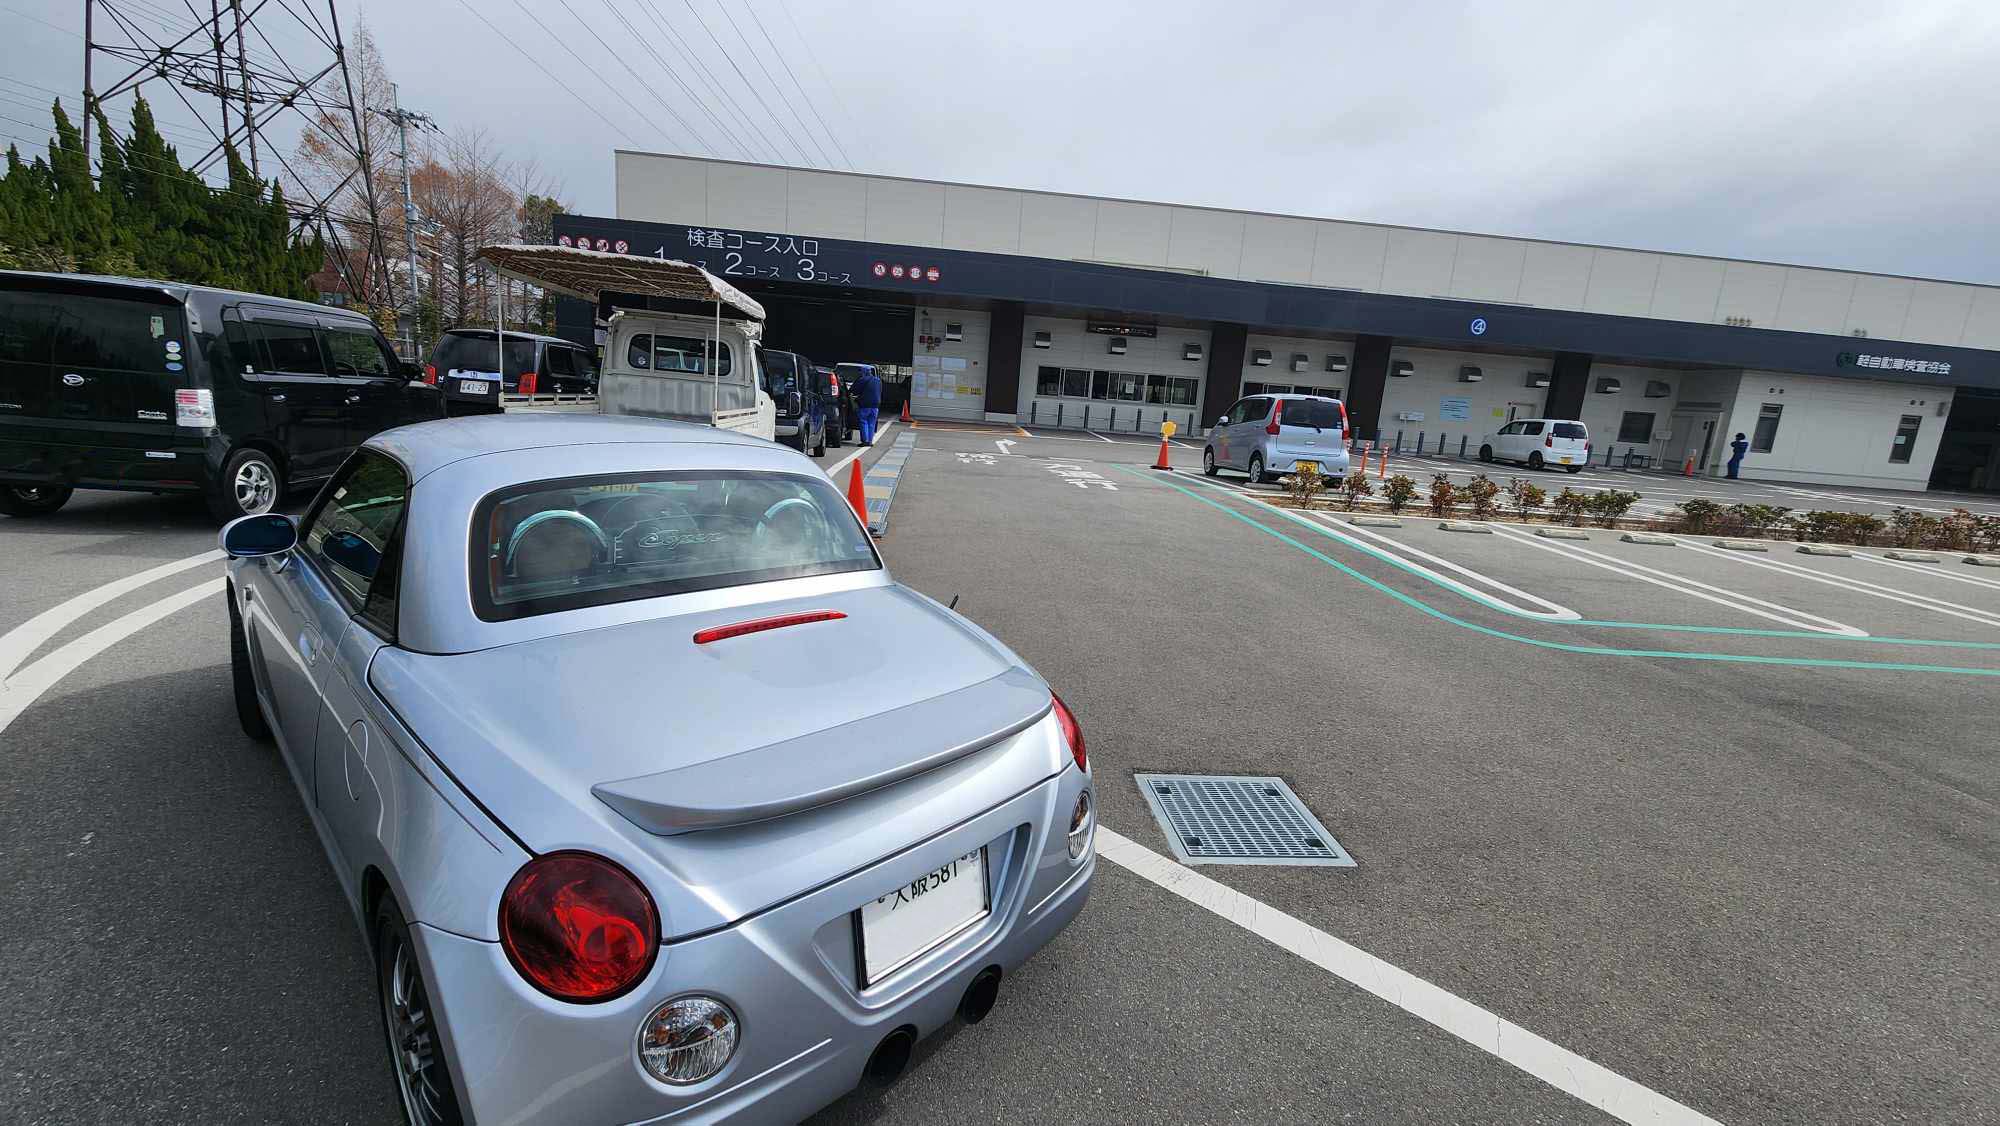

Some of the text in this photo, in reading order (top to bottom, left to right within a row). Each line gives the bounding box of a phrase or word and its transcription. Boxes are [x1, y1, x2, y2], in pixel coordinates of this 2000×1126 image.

[688, 228, 818, 256] 検査コース入口
